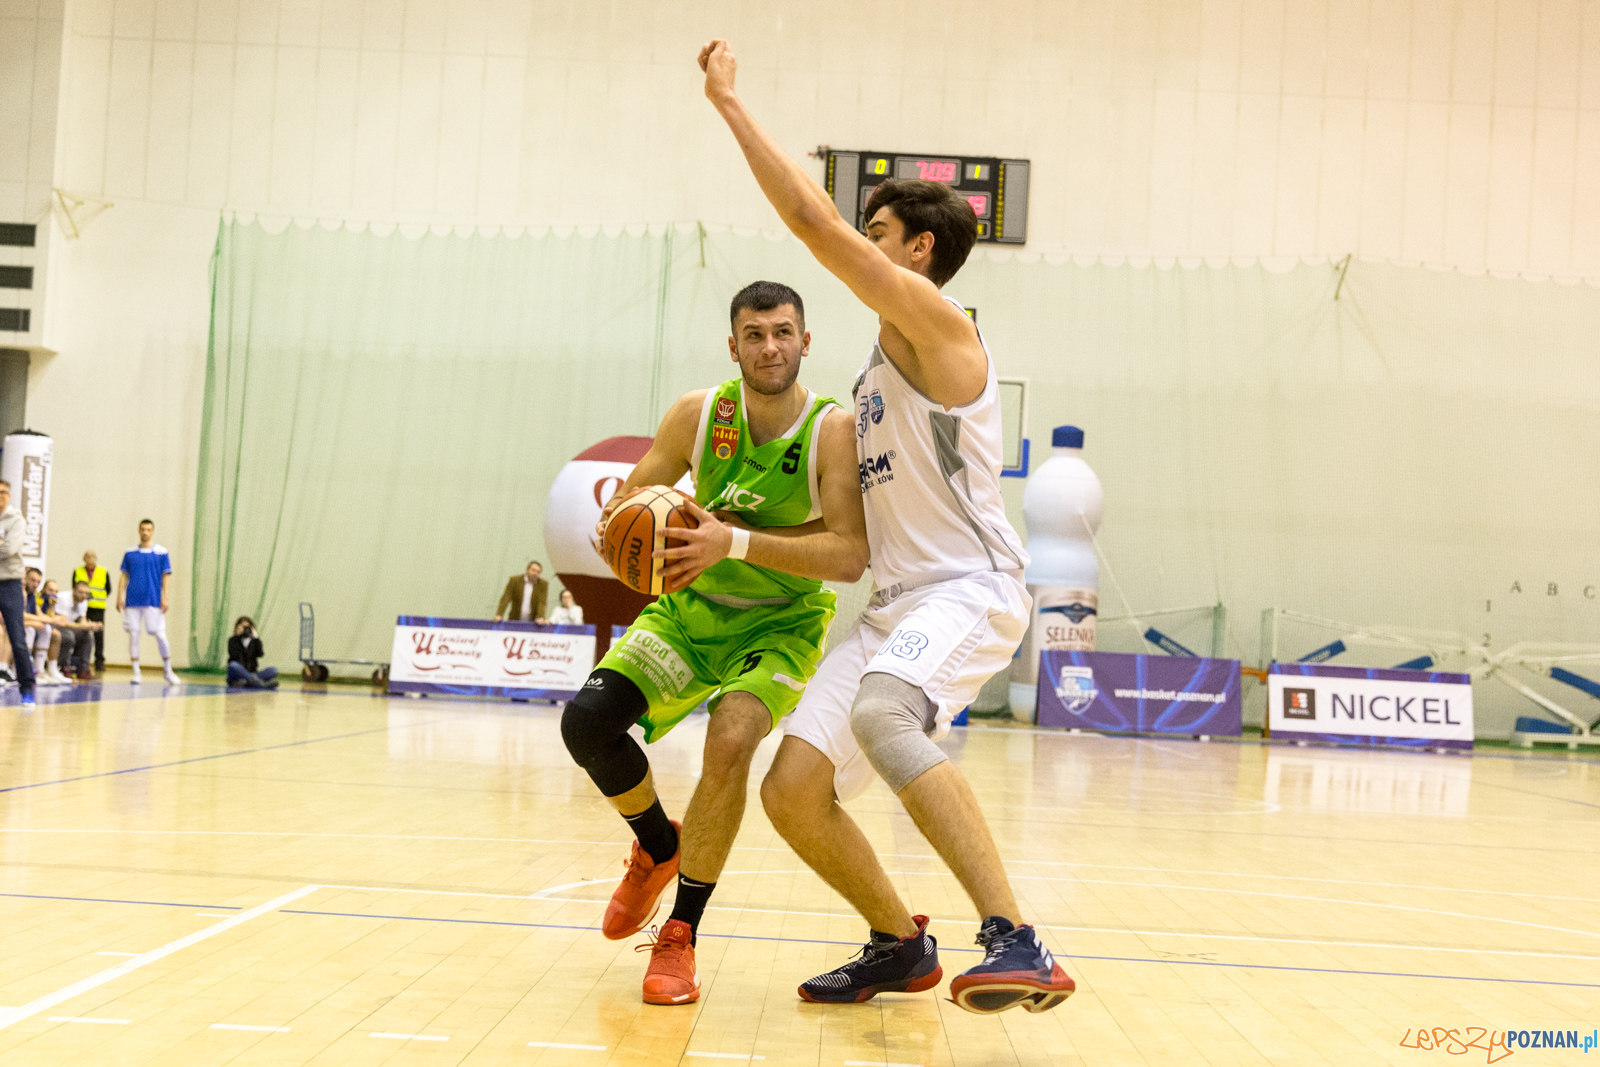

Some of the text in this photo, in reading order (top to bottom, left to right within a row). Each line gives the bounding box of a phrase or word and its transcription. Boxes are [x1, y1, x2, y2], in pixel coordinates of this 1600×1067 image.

[874, 159, 887, 174] 0
[974, 165, 981, 179] 1
[781, 442, 802, 474] 5
[23, 461, 43, 555] Magnefar
[1511, 581, 1596, 599] A B C
[633, 633, 669, 660] LOGO
[878, 629, 929, 661] 13
[738, 649, 765, 677] 5
[1114, 688, 1227, 704] www.basket.poznan.pl
[1331, 693, 1461, 725] NICKEL
